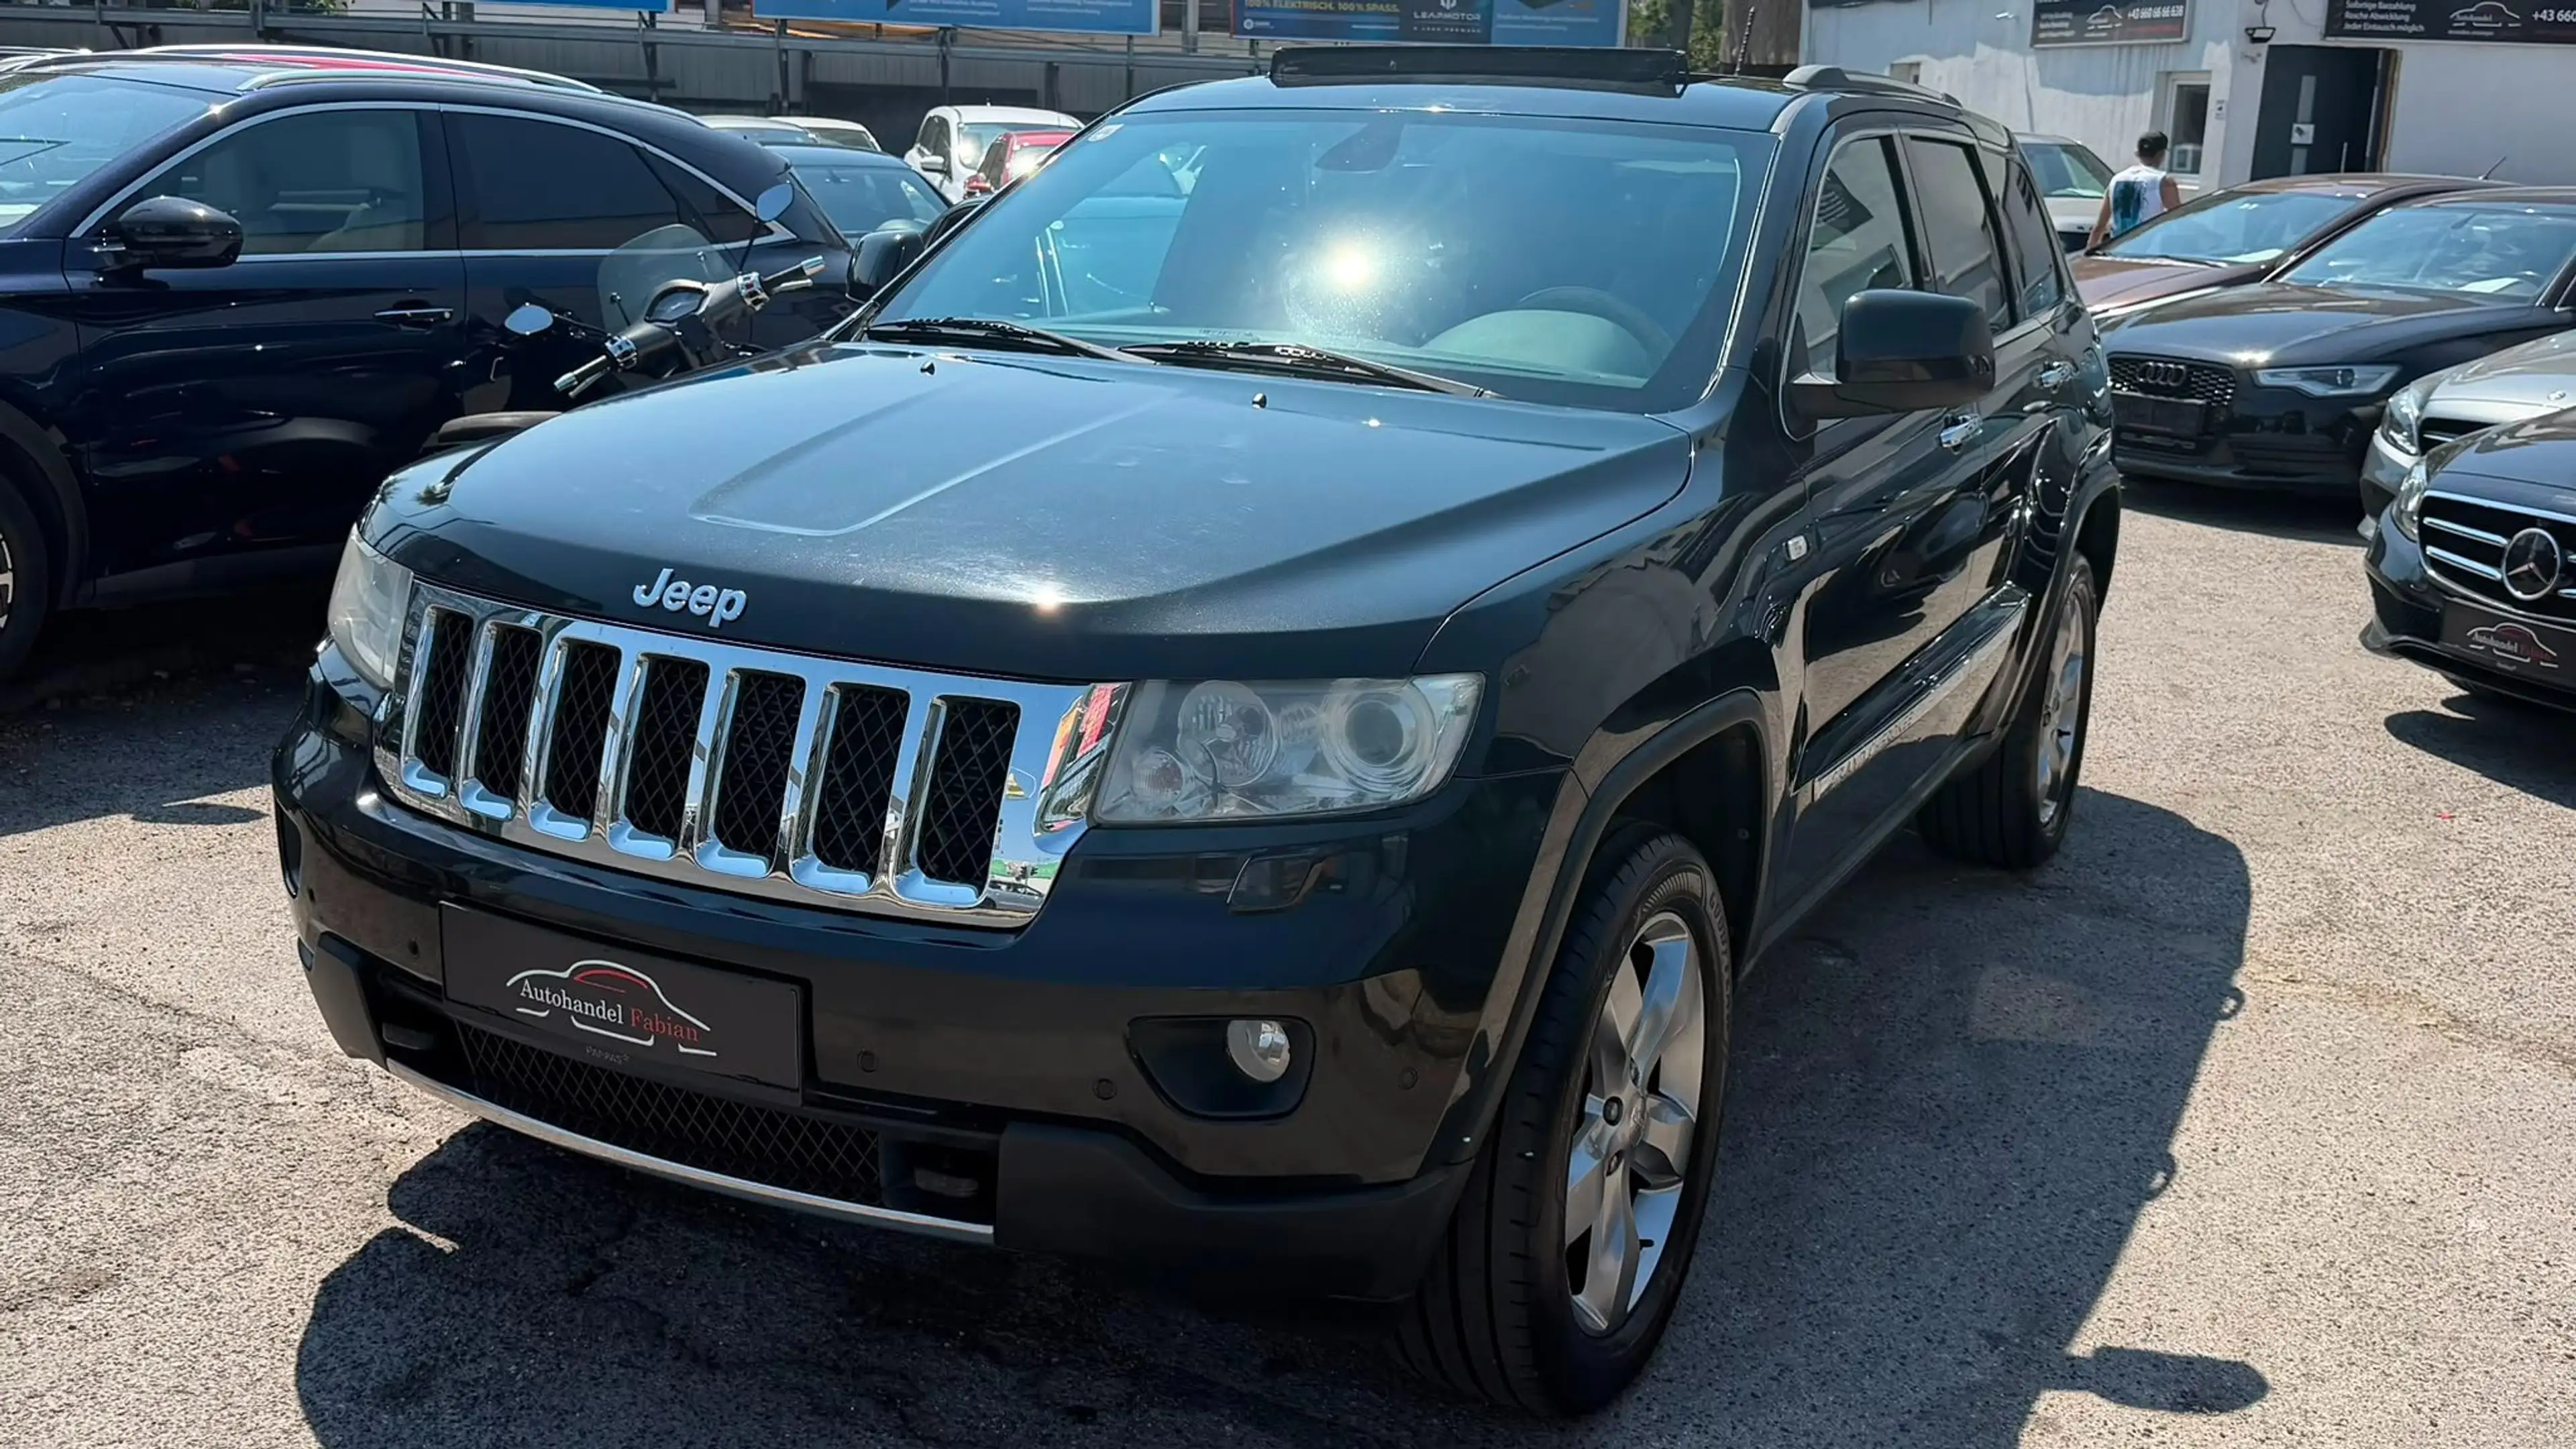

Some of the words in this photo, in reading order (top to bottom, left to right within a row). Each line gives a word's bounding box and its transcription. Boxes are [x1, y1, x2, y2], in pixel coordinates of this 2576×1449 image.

[2532, 9, 2555, 21] +43
[633, 568, 747, 629] Jeep
[520, 979, 624, 1024] Autohandel
[630, 1008, 699, 1042] Fabian
